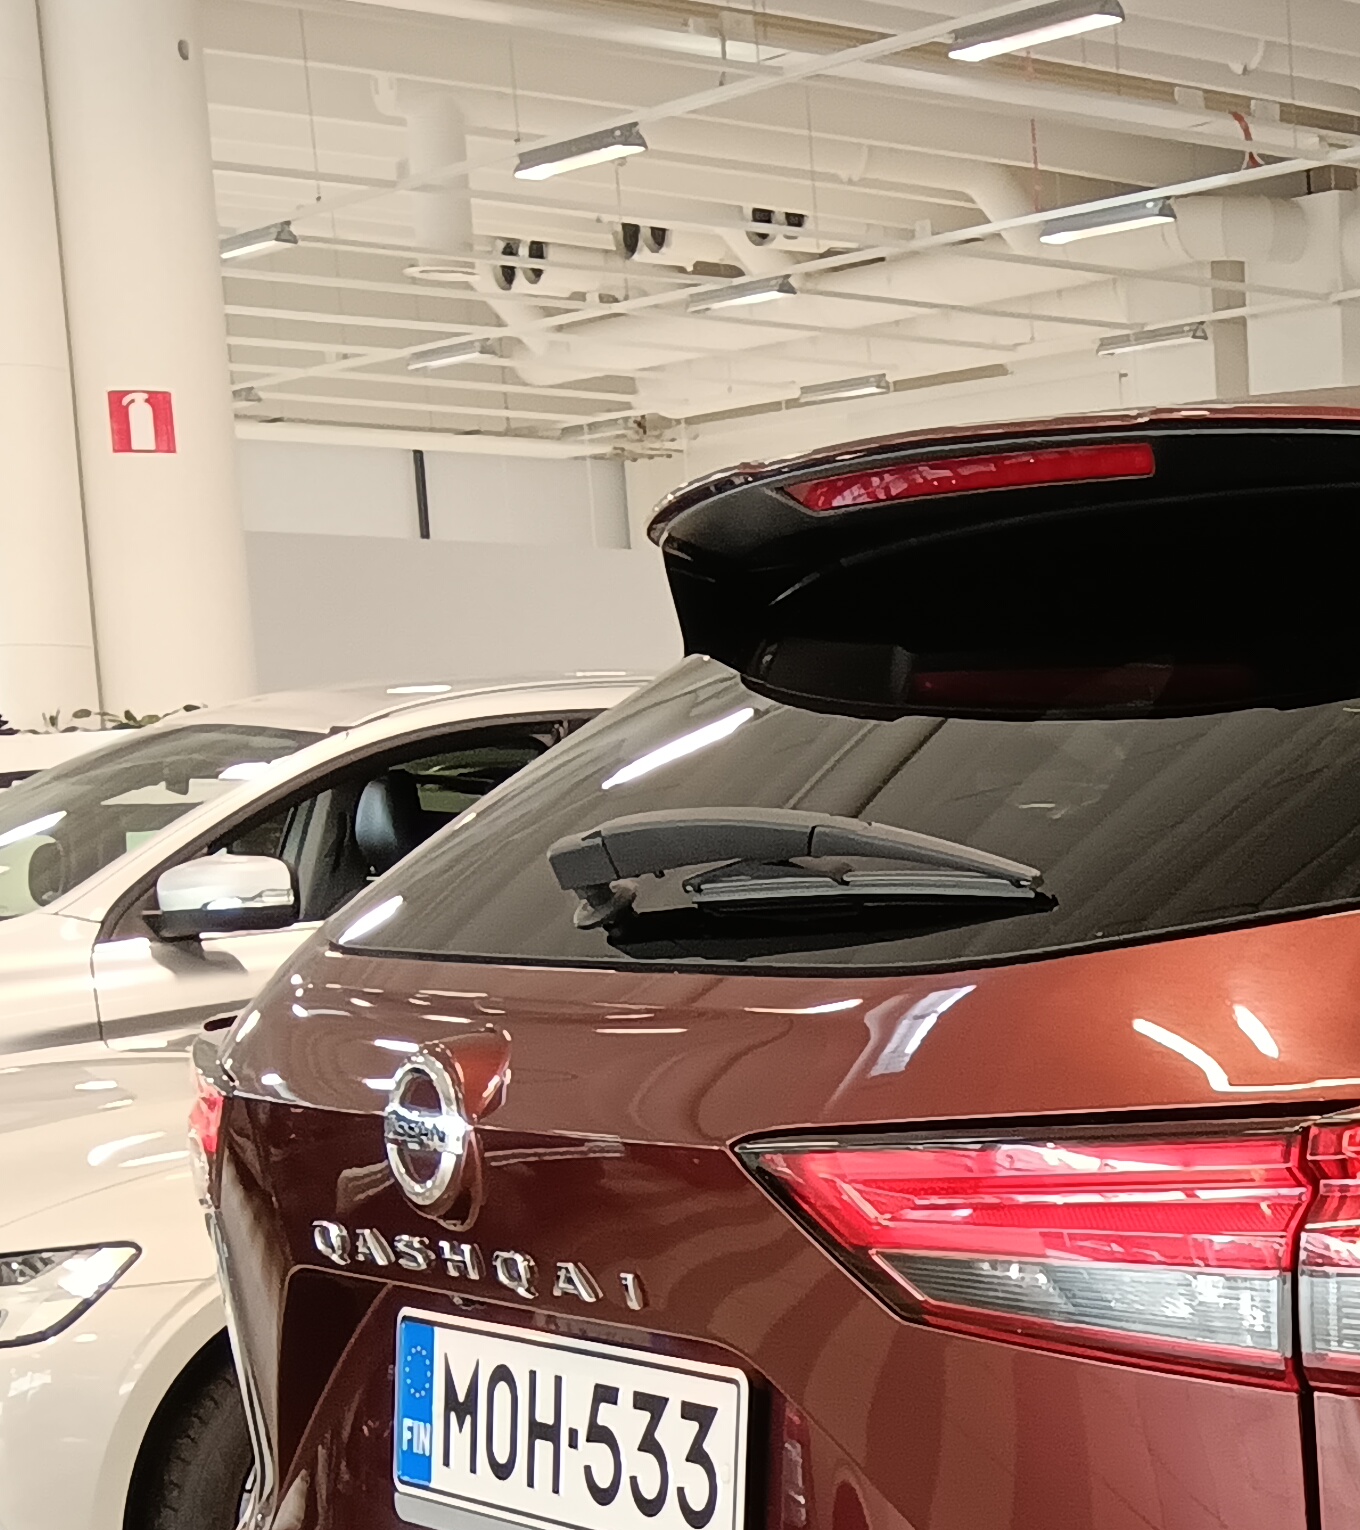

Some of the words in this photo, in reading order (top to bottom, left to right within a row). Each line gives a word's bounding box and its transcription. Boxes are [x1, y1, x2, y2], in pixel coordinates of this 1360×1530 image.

[311, 1220, 645, 1310] QASHQAI
[402, 1417, 431, 1457] FIN
[442, 1352, 719, 1530] MOH-533
